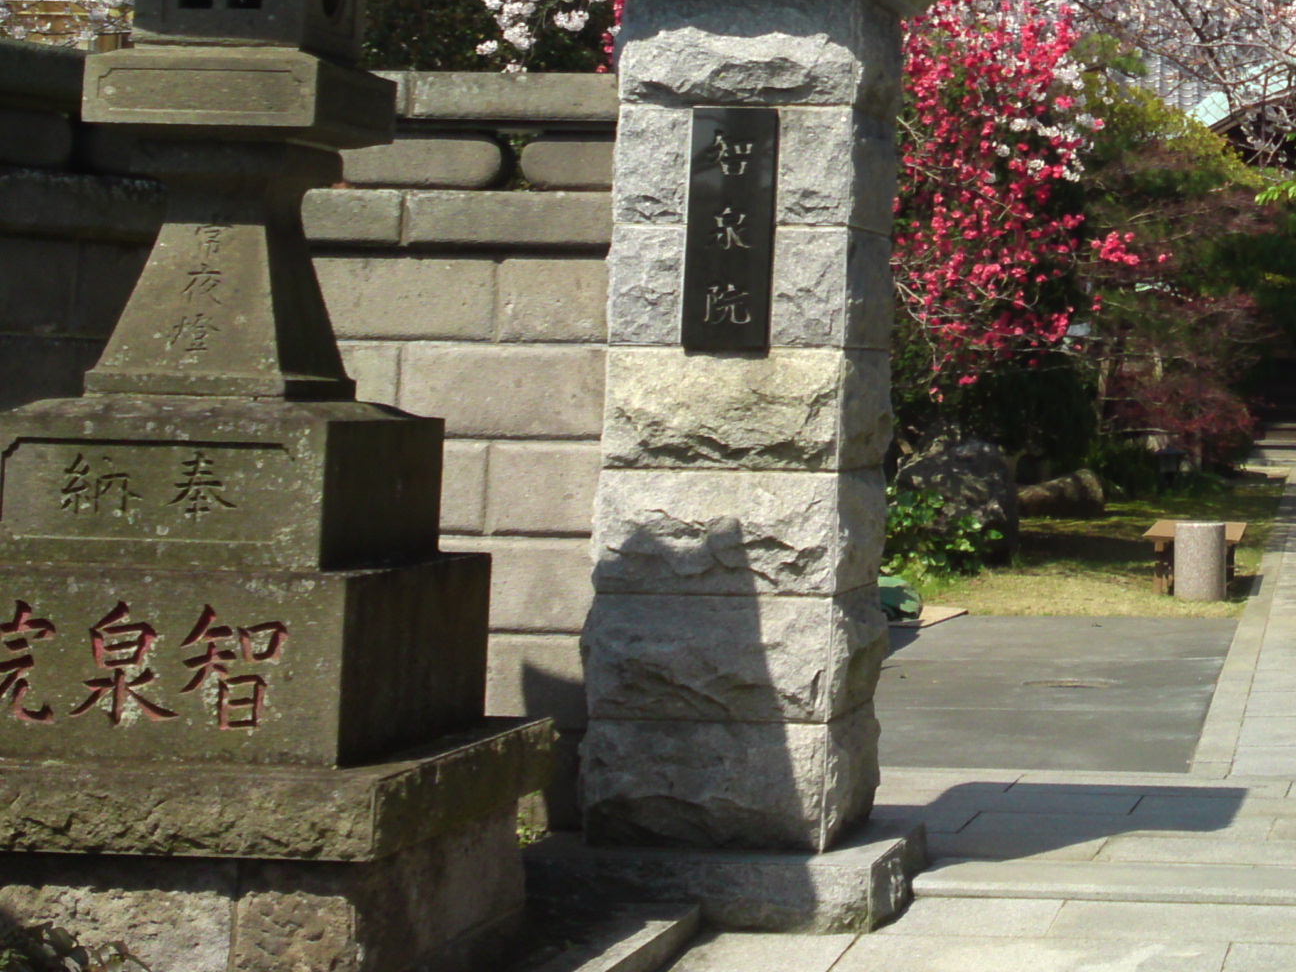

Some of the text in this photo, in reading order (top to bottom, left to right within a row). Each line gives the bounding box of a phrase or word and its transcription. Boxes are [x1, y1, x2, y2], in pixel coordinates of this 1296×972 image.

[703, 129, 754, 325] 智泉院
[61, 450, 237, 523] 奉納
